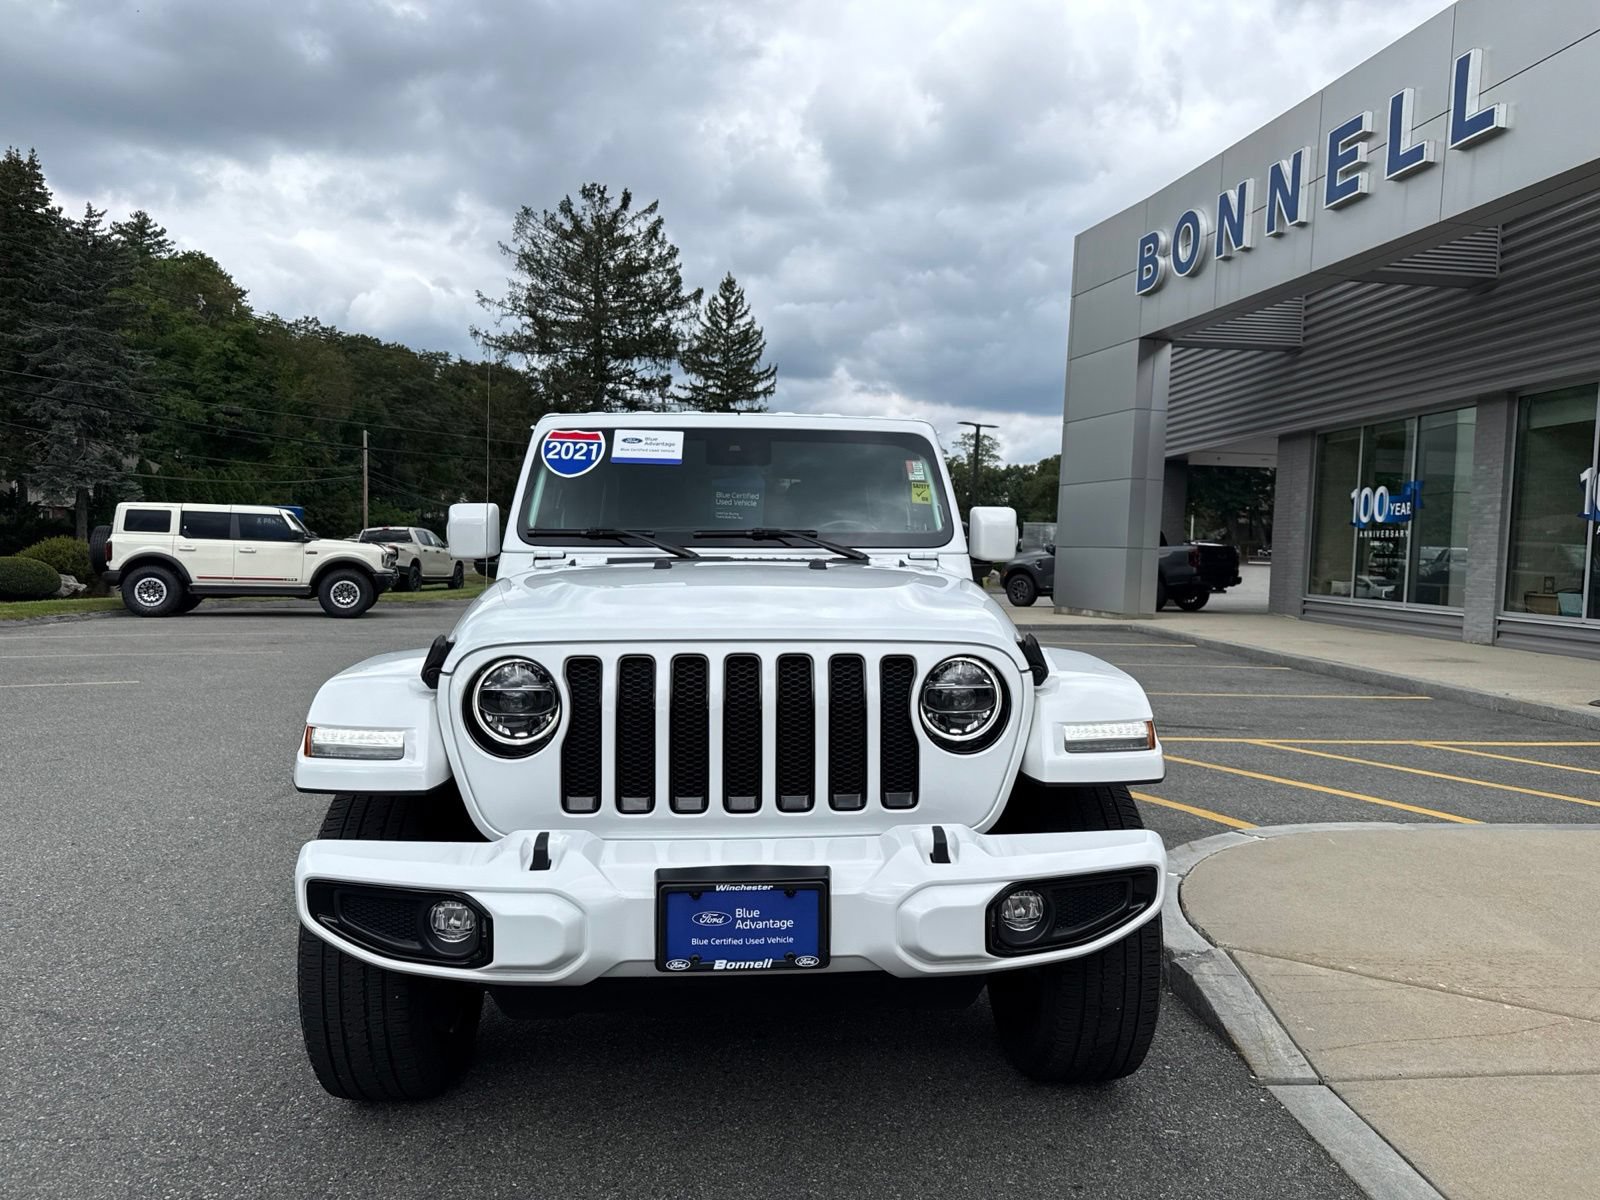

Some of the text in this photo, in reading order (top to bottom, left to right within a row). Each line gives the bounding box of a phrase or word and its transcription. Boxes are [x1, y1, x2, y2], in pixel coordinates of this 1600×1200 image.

[1136, 48, 1507, 295] BONNELL
[546, 442, 599, 461] 2021
[715, 491, 760, 500] Blue Certified
[1350, 485, 1389, 523] 100
[1359, 529, 1409, 538] ANNIVERSARY
[715, 884, 773, 892] Winchester
[698, 912, 726, 925] Ford
[735, 908, 760, 918] Blue
[735, 918, 794, 930] Advantage
[691, 936, 794, 946] Blue Certified Used Vehicle
[668, 957, 818, 970] Ford Bonnell Ford
